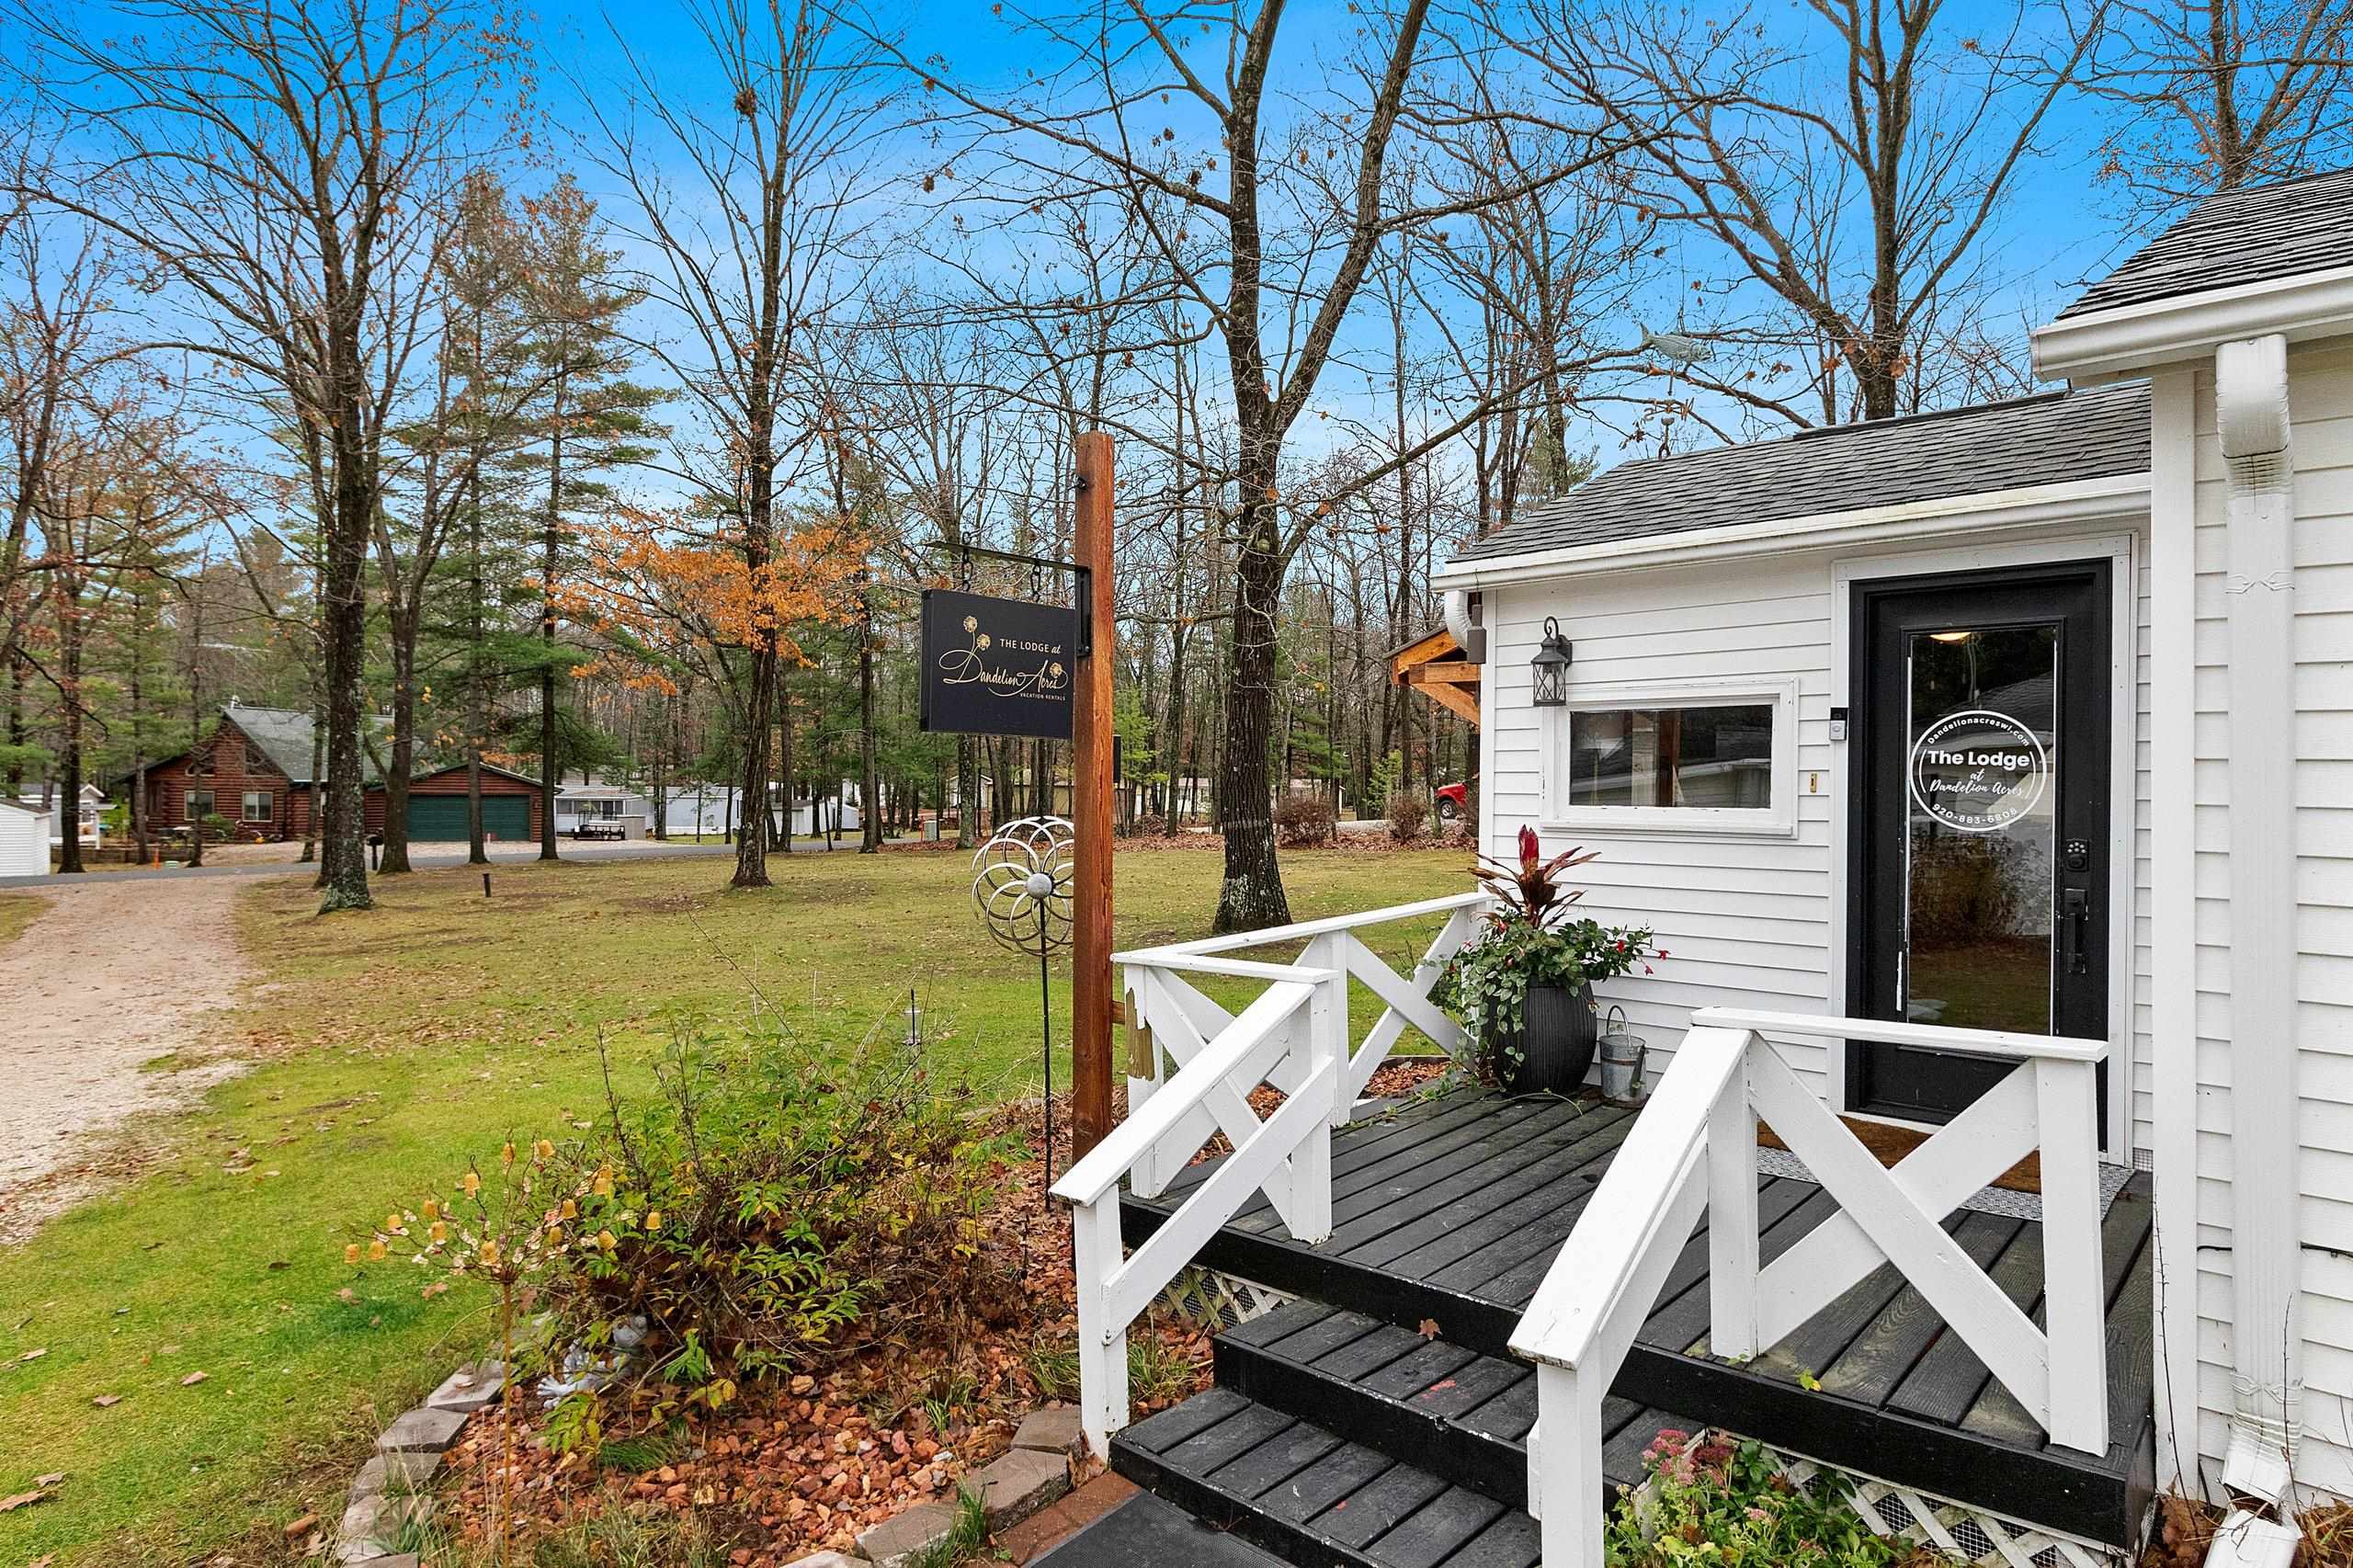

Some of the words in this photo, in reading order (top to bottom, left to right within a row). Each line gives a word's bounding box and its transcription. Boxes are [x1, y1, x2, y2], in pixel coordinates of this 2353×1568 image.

[999, 638, 1017, 649] THE
[1019, 641, 1050, 653] LODGE
[1051, 643, 1062, 654] at
[938, 649, 1022, 687] Dandelion
[1927, 750, 1964, 765] The
[1968, 751, 2029, 770] Lodge
[1970, 767, 1985, 782] at
[1929, 778, 1989, 794] Dandelion
[1992, 782, 2022, 796] Acres
